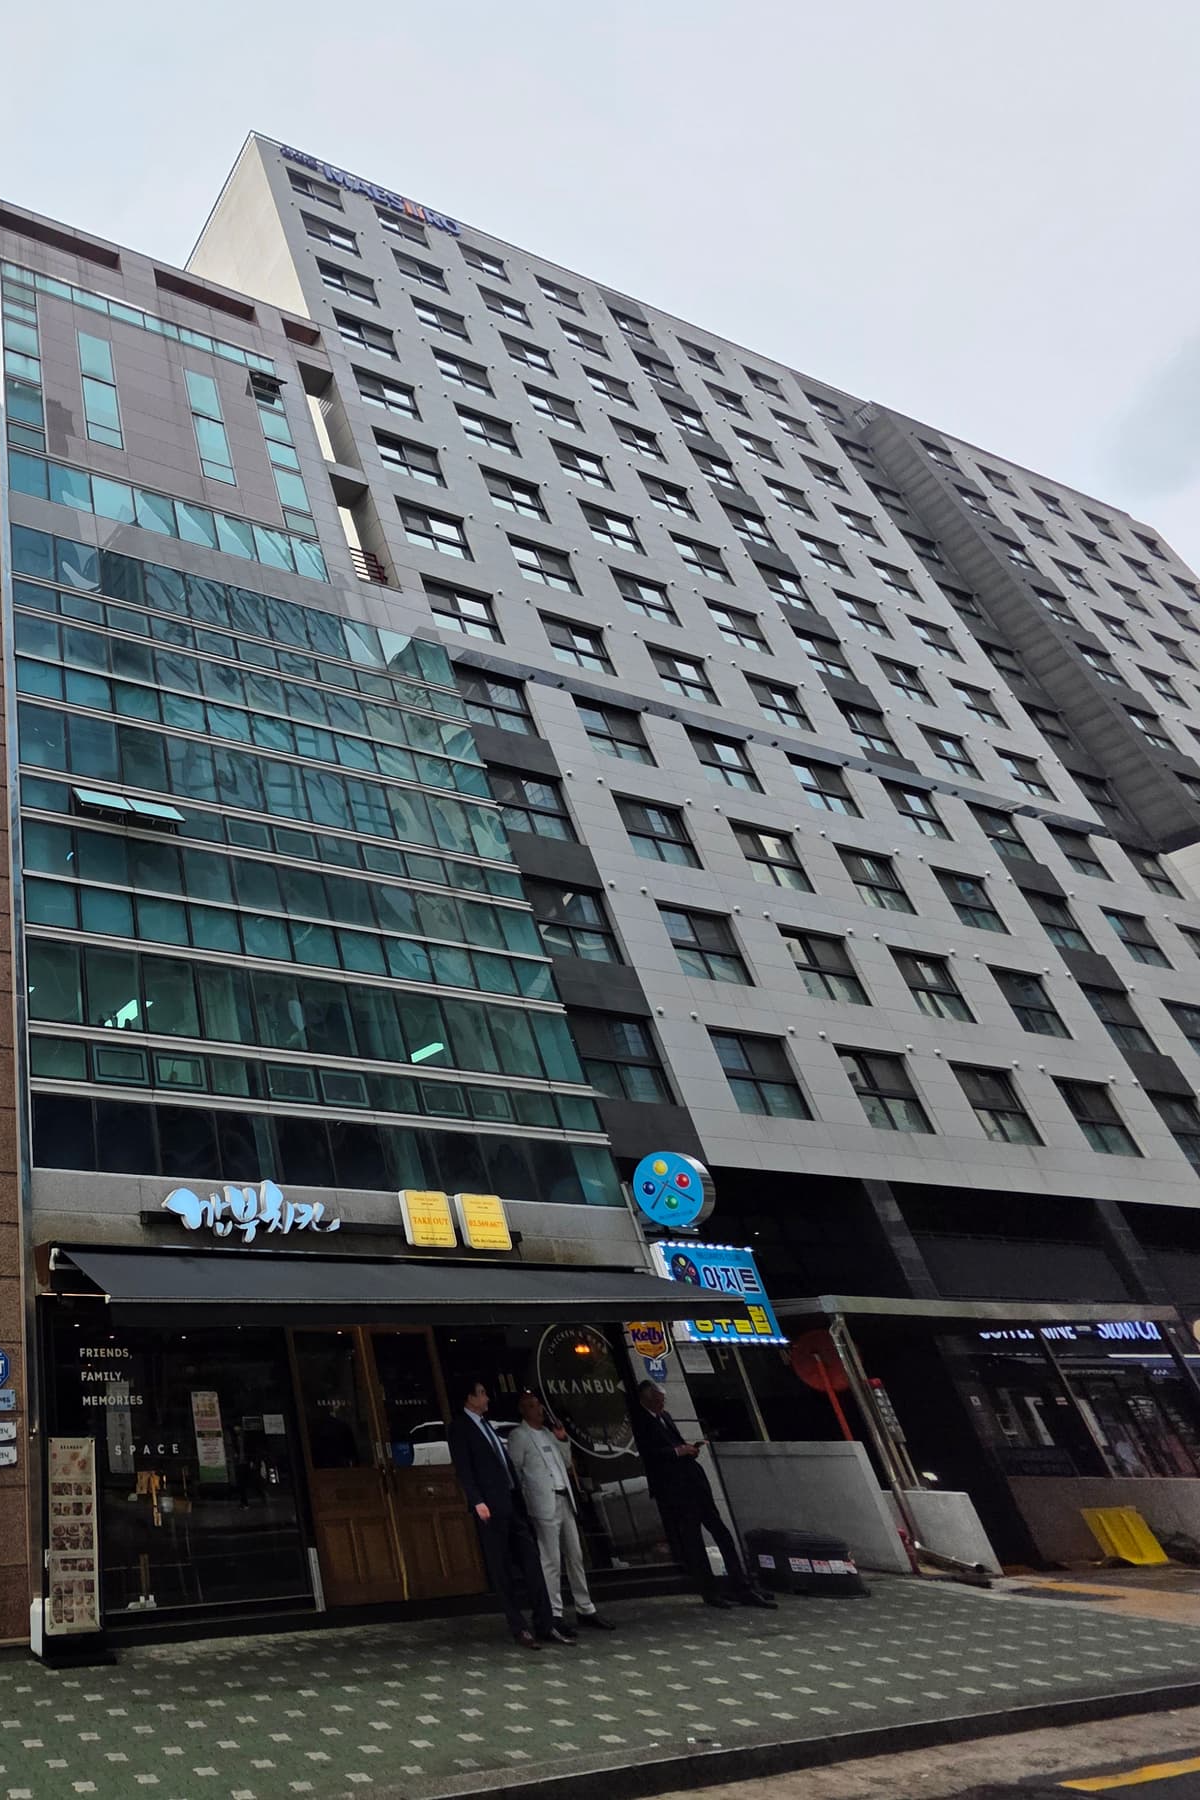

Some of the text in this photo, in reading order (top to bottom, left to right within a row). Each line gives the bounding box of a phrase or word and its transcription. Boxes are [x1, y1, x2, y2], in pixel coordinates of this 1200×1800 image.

[702, 1265, 761, 1293] 아지트
[631, 1327, 664, 1345] Kelly
[79, 1347, 133, 1359] FRIENDS,
[82, 1394, 144, 1407] MEMORIES
